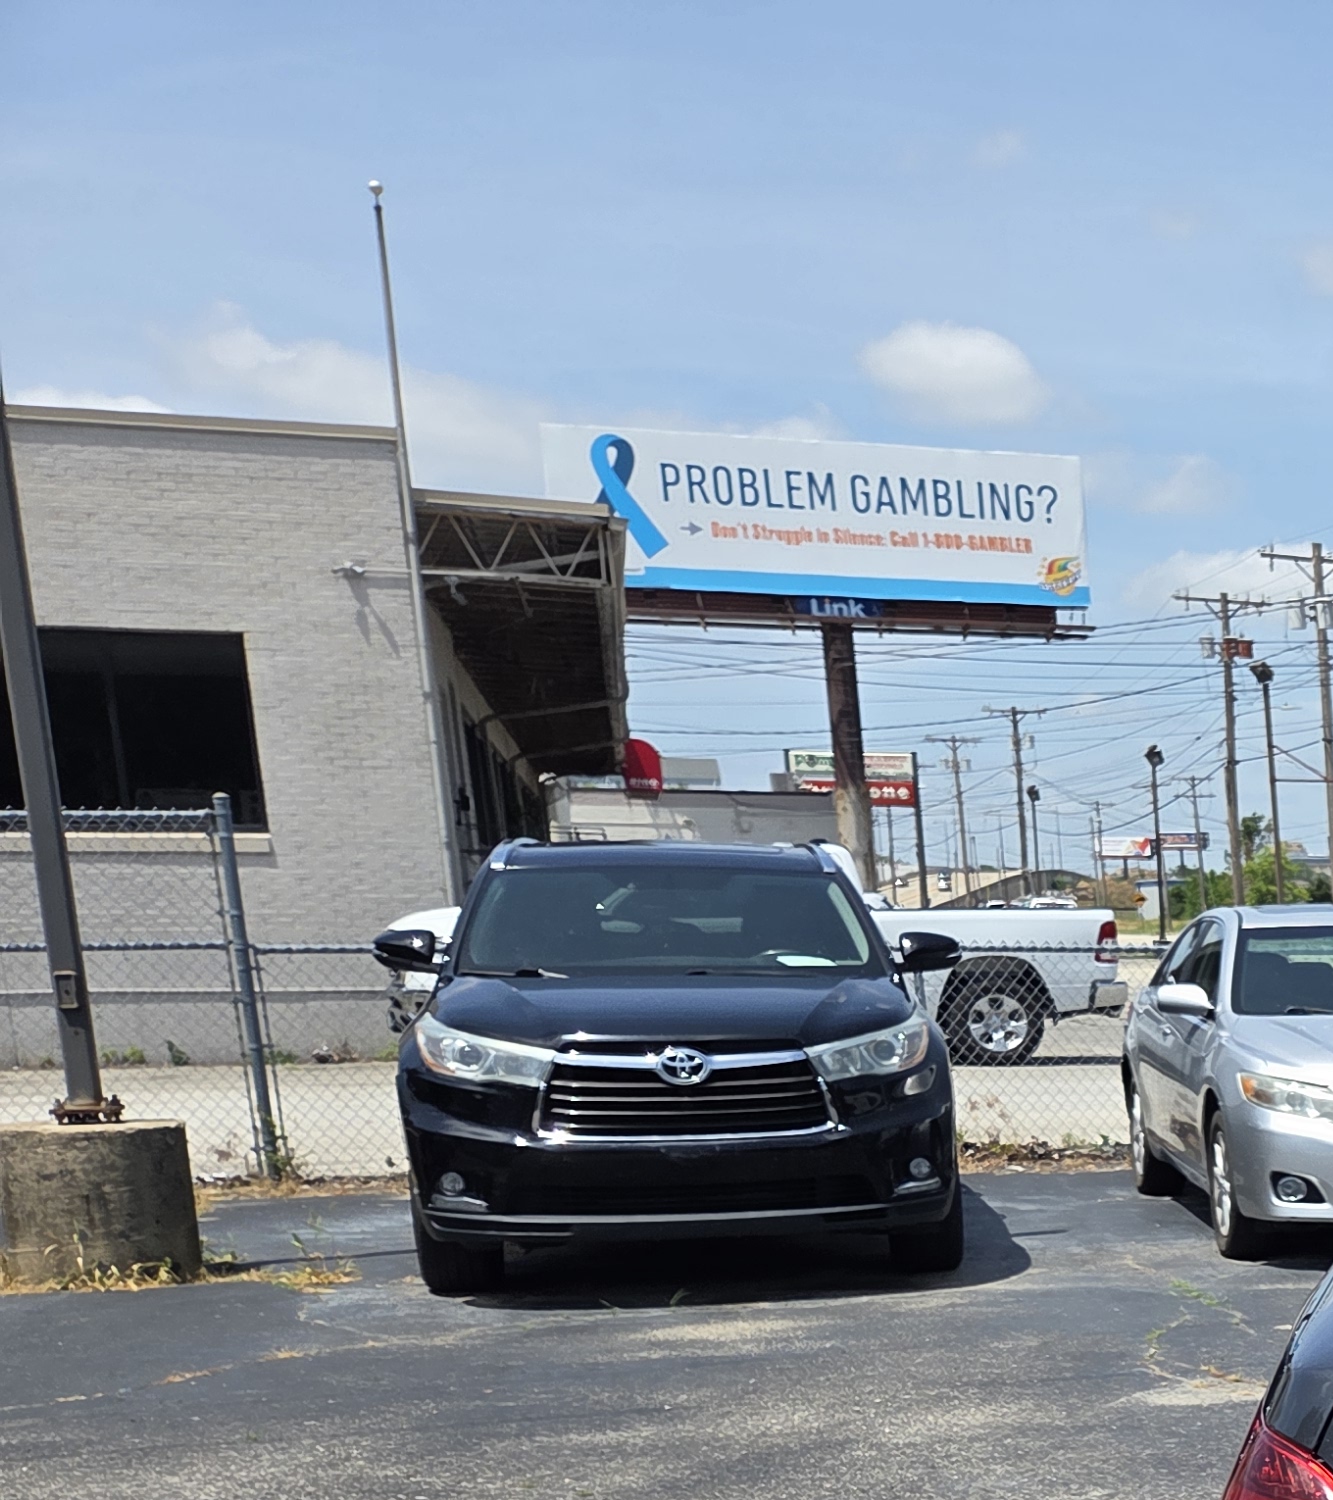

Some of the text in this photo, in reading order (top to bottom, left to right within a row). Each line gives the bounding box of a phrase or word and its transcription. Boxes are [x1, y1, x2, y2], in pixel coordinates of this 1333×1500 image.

[659, 462, 1059, 524] PROBLEM GAMBLING?
[710, 521, 749, 539] Don't
[751, 523, 813, 546] Struggle
[889, 530, 919, 548] Call
[921, 531, 1033, 554] 1-800-GAMBLER
[810, 597, 869, 619] Link
